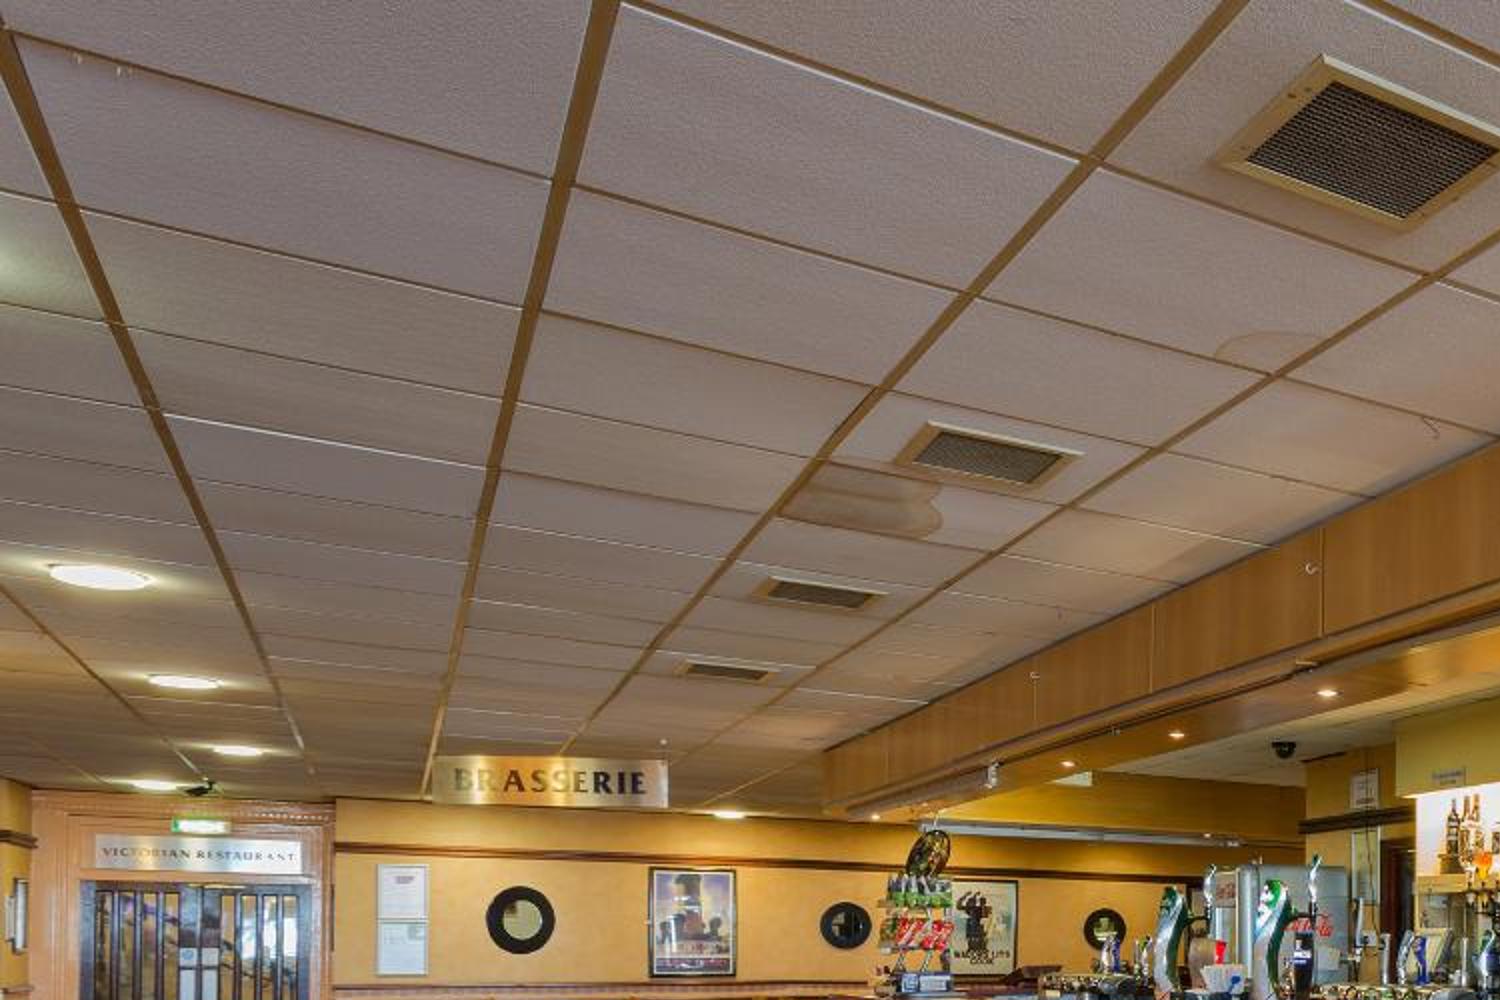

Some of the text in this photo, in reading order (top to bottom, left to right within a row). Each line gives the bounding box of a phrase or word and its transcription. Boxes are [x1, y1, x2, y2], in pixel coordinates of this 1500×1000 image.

[455, 767, 646, 795] BRASSERIE
[102, 846, 295, 862] VICTORIAN RESTAURANT
